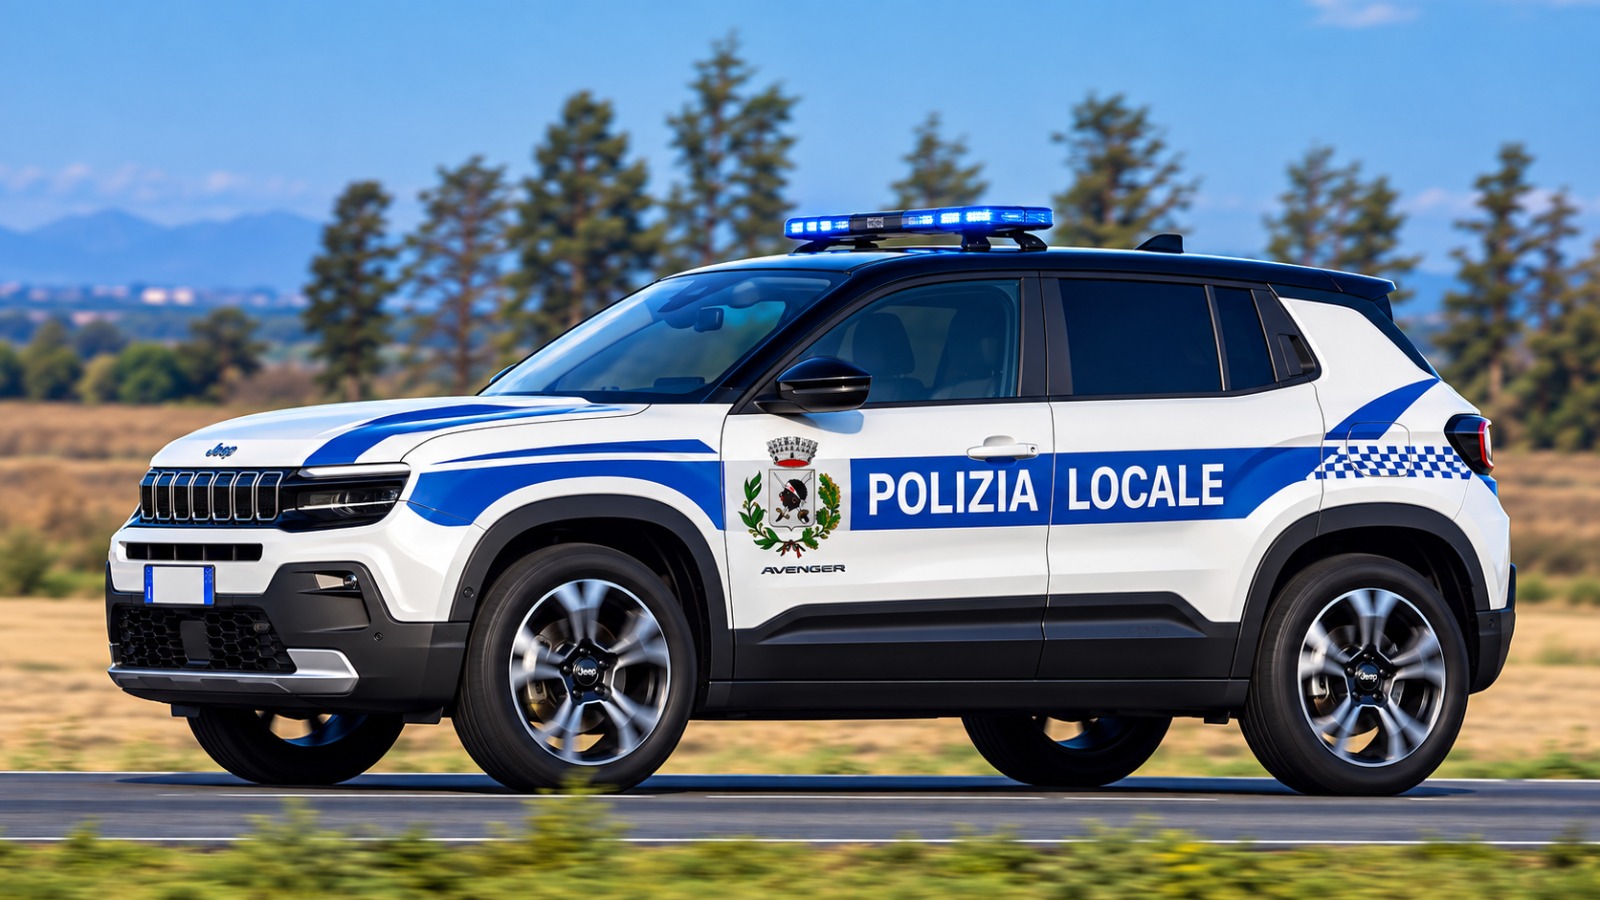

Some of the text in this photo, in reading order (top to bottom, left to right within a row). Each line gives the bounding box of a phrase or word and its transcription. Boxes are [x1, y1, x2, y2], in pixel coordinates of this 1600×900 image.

[205, 442, 237, 460] Jeep
[868, 463, 1224, 516] POLIZIA LOCALE
[761, 564, 846, 575] AVENGER
[577, 666, 597, 677] Jeep
[1360, 671, 1378, 683] Jeep
